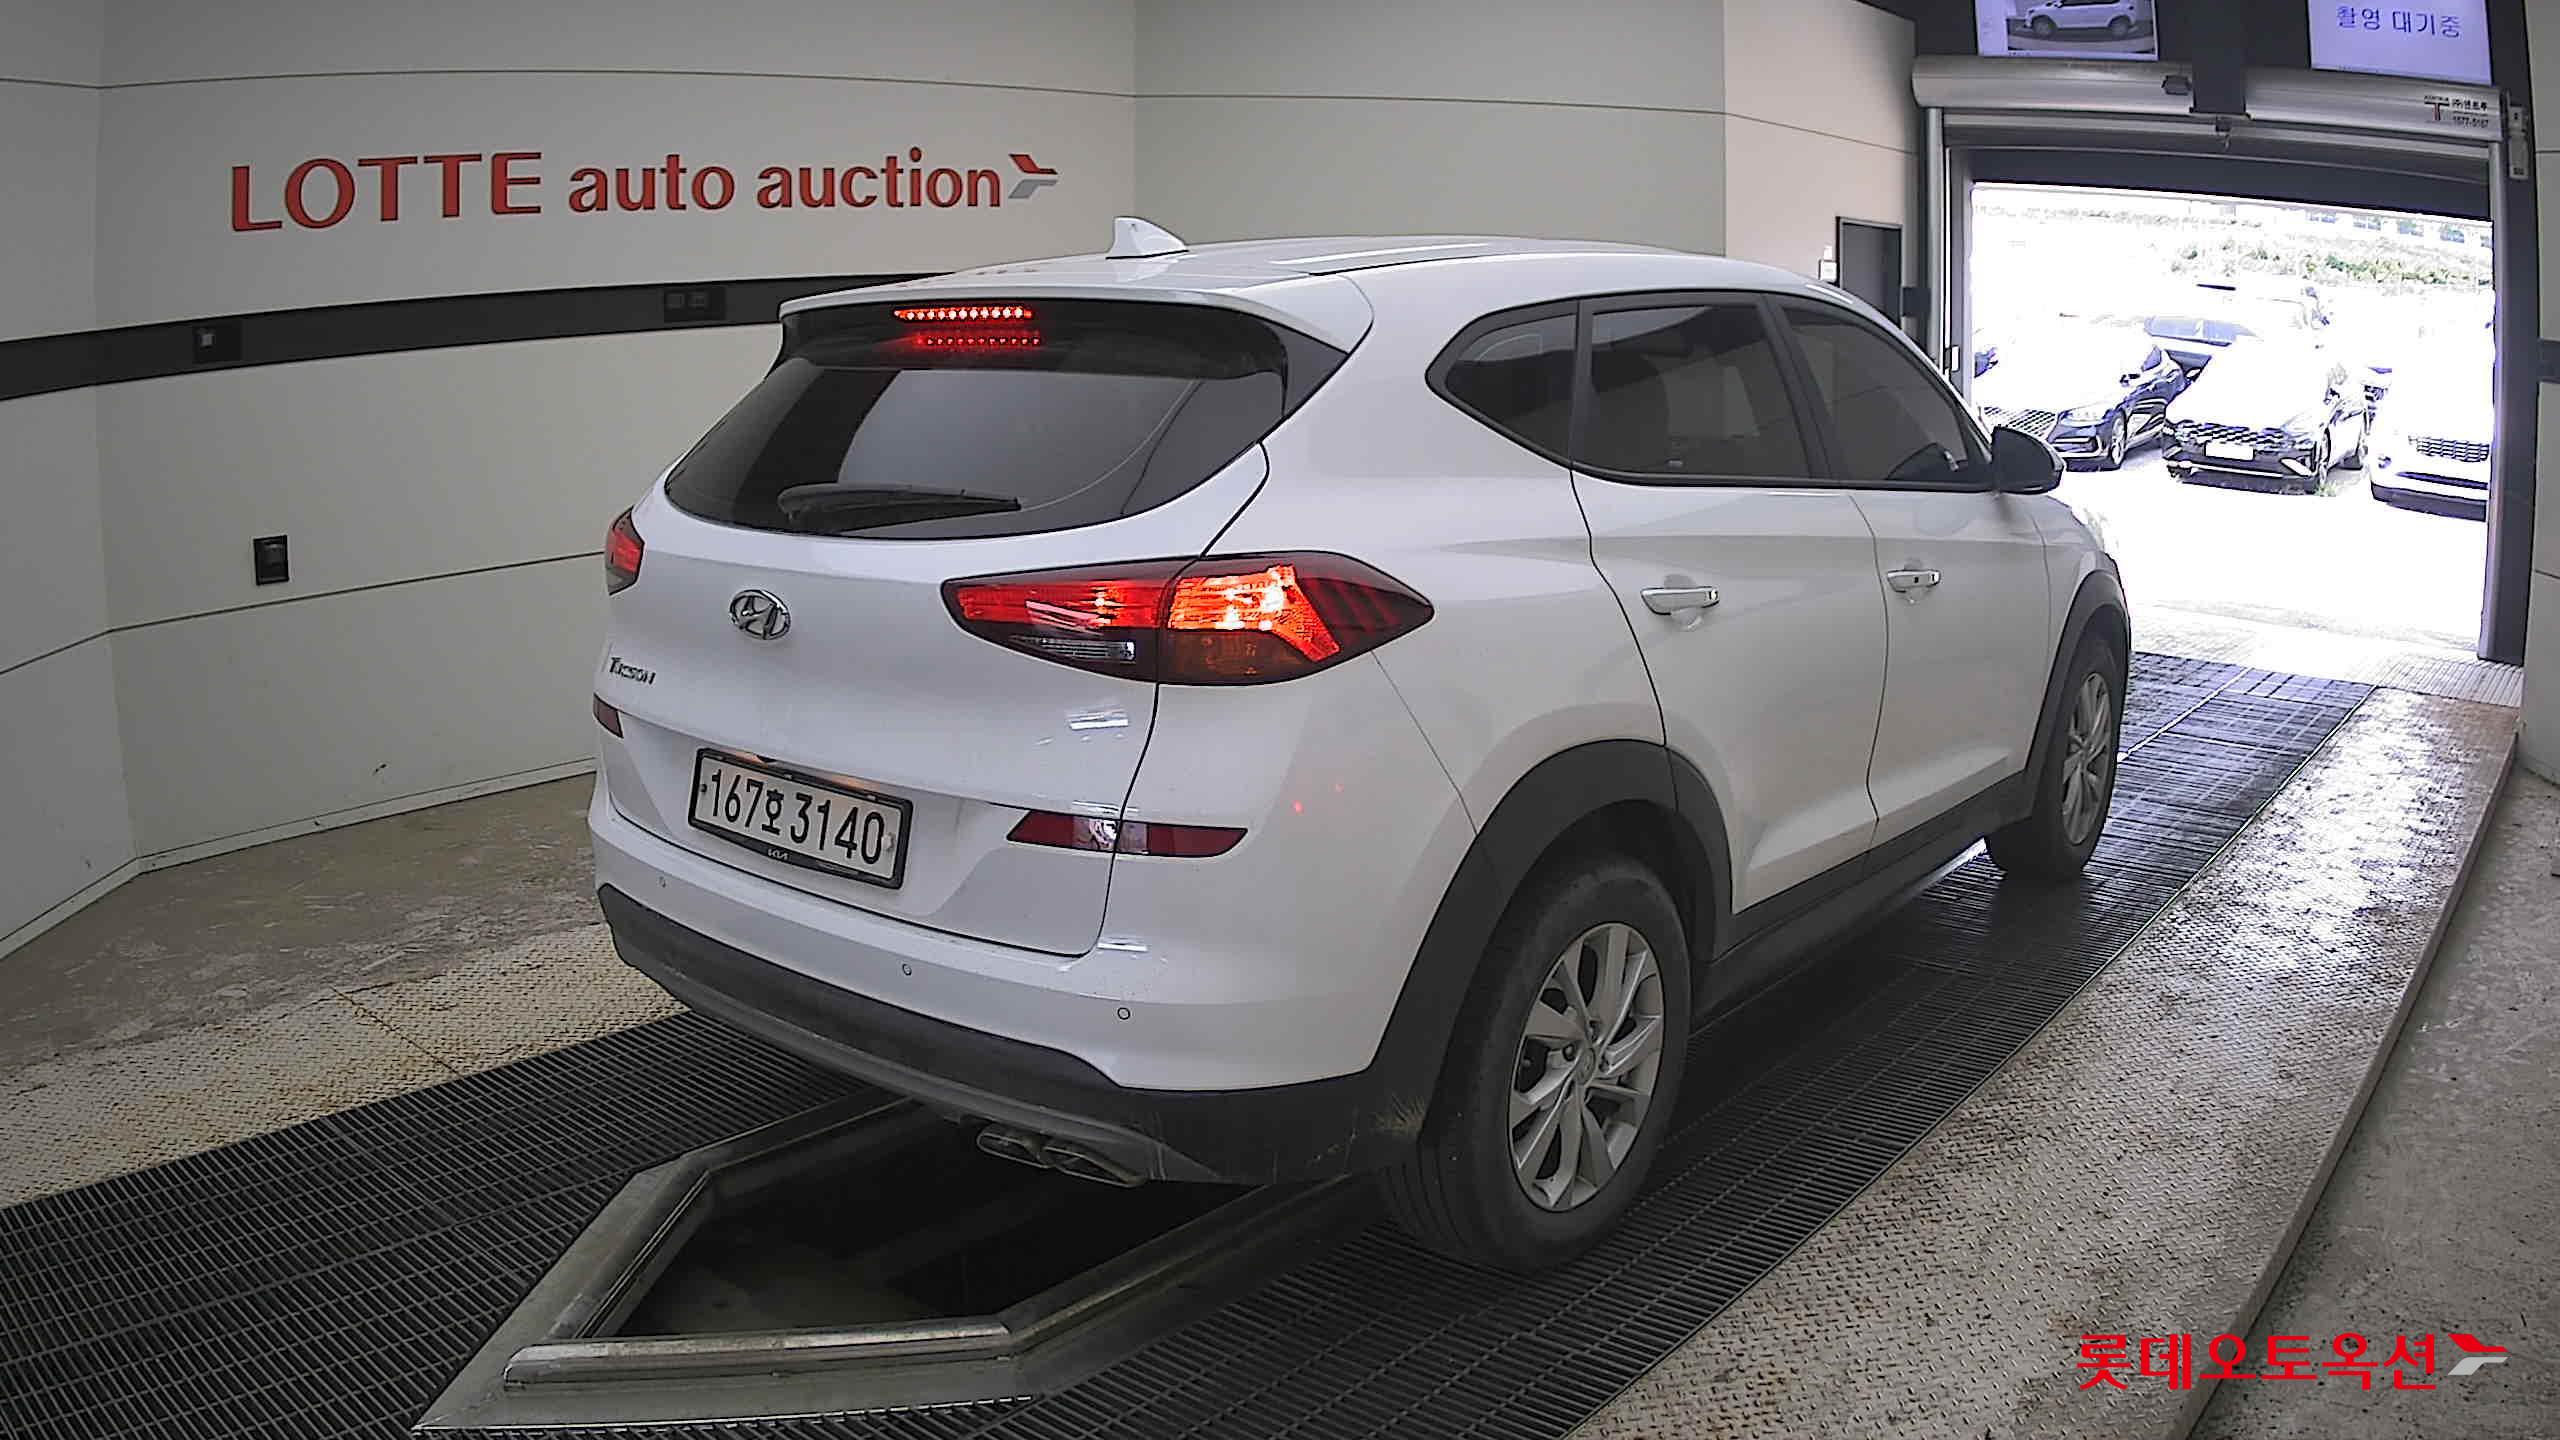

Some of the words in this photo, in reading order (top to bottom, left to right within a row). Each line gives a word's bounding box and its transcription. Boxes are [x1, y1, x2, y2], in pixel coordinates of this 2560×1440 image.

[2336, 6, 2381, 31] 촬영
[2392, 11, 2462, 38] 대기중
[231, 152, 541, 232] LOTTE
[568, 153, 735, 213] auto
[756, 147, 1001, 209] auction
